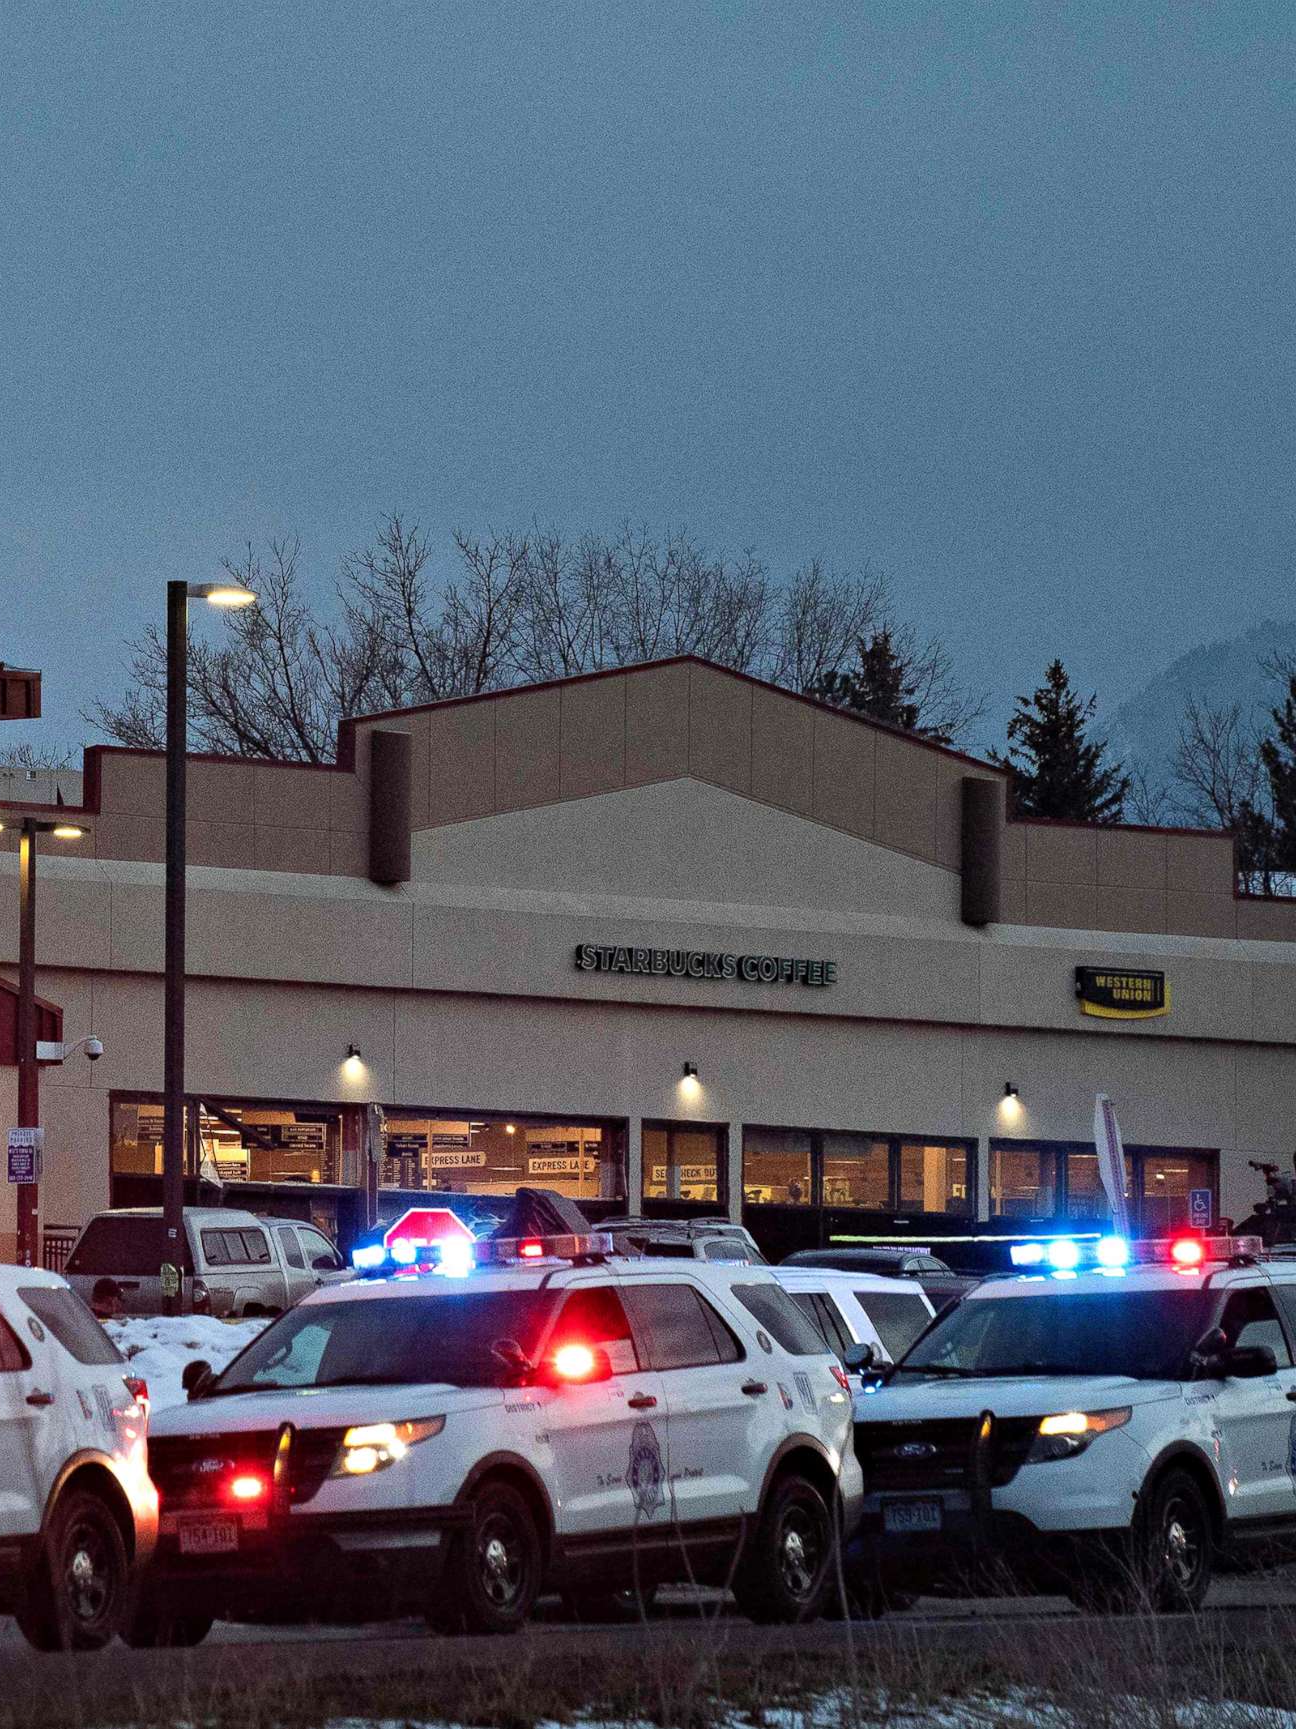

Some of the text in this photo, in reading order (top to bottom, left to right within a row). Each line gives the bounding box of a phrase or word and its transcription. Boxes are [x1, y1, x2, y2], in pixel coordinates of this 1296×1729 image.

[576, 944, 837, 986] STARBUCKS COFFEE
[1095, 975, 1151, 990] WESTERN
[1113, 989, 1151, 1001] UNION
[462, 1155, 481, 1165] LANE
[532, 1161, 589, 1170] EXPRESS LAE
